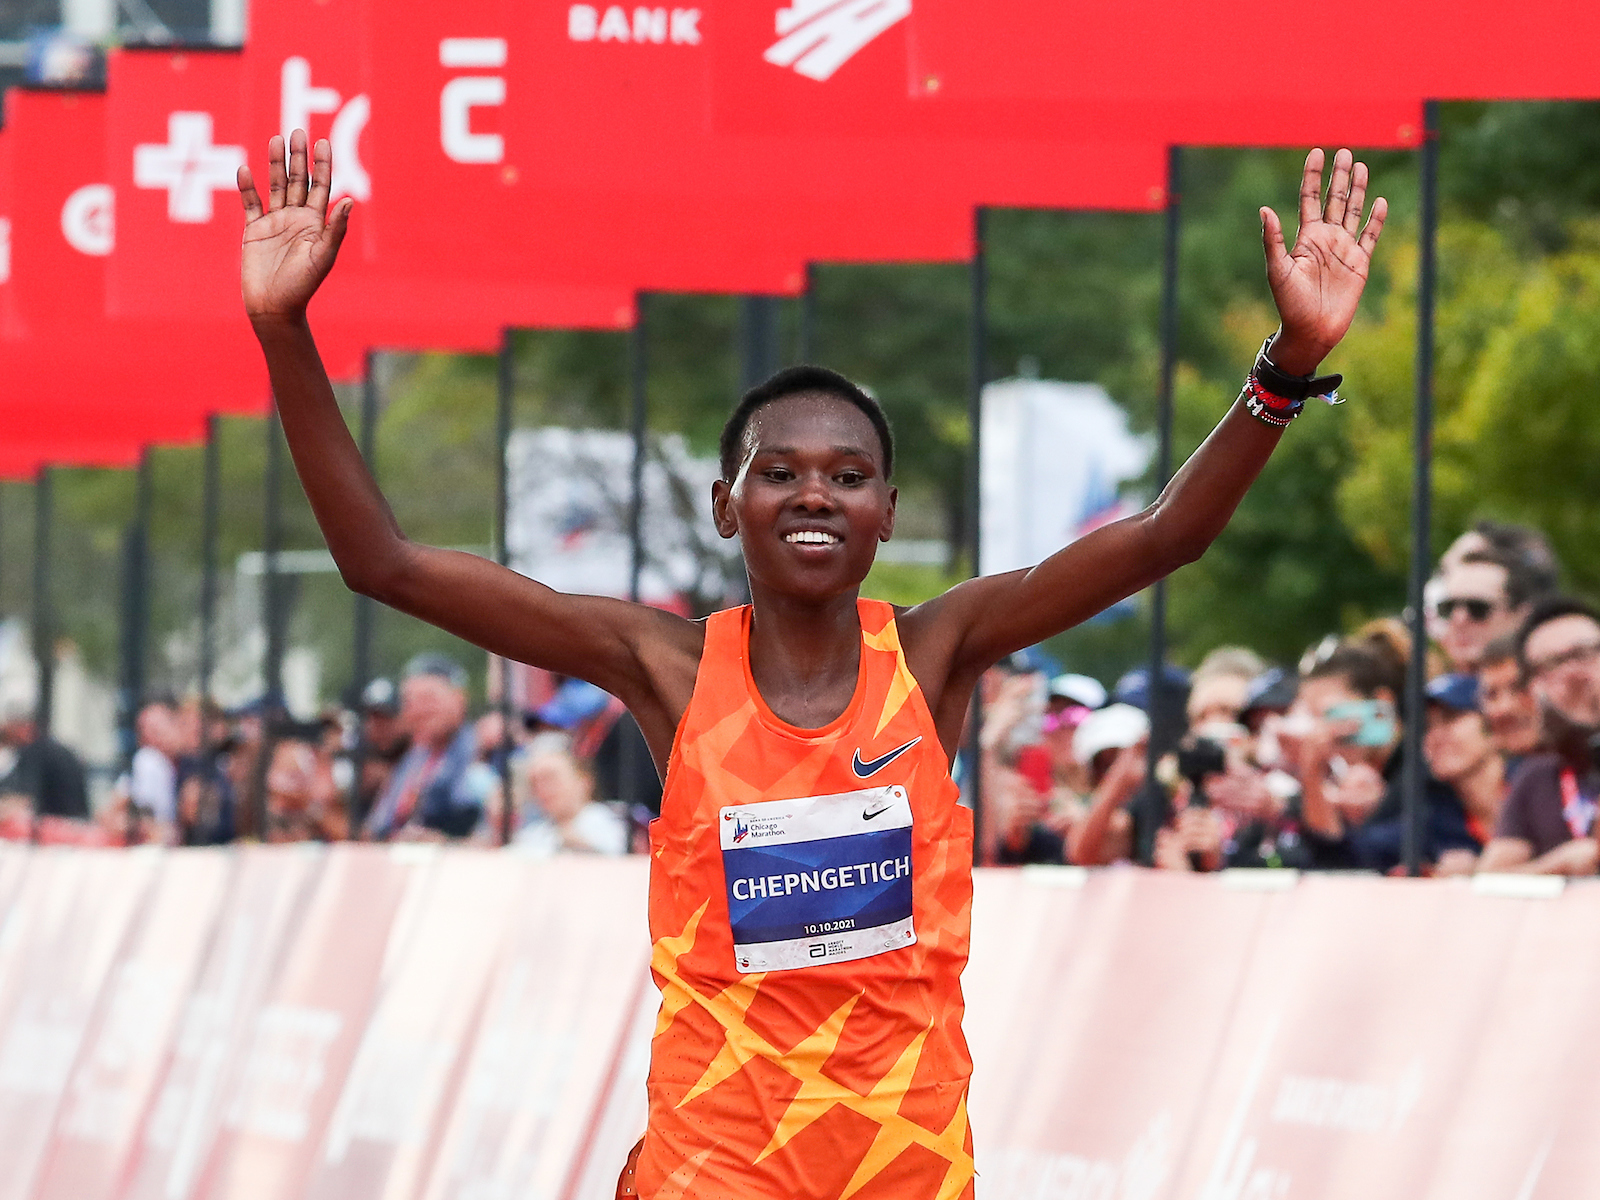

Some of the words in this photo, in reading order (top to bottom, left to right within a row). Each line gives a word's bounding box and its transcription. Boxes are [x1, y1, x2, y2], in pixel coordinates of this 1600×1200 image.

[567, 3, 703, 45] BANK
[750, 823, 778, 831] Chicago
[751, 829, 786, 839] Marathon
[732, 855, 911, 901] CHEPNGETICH
[804, 918, 856, 935] 10.10.2021
